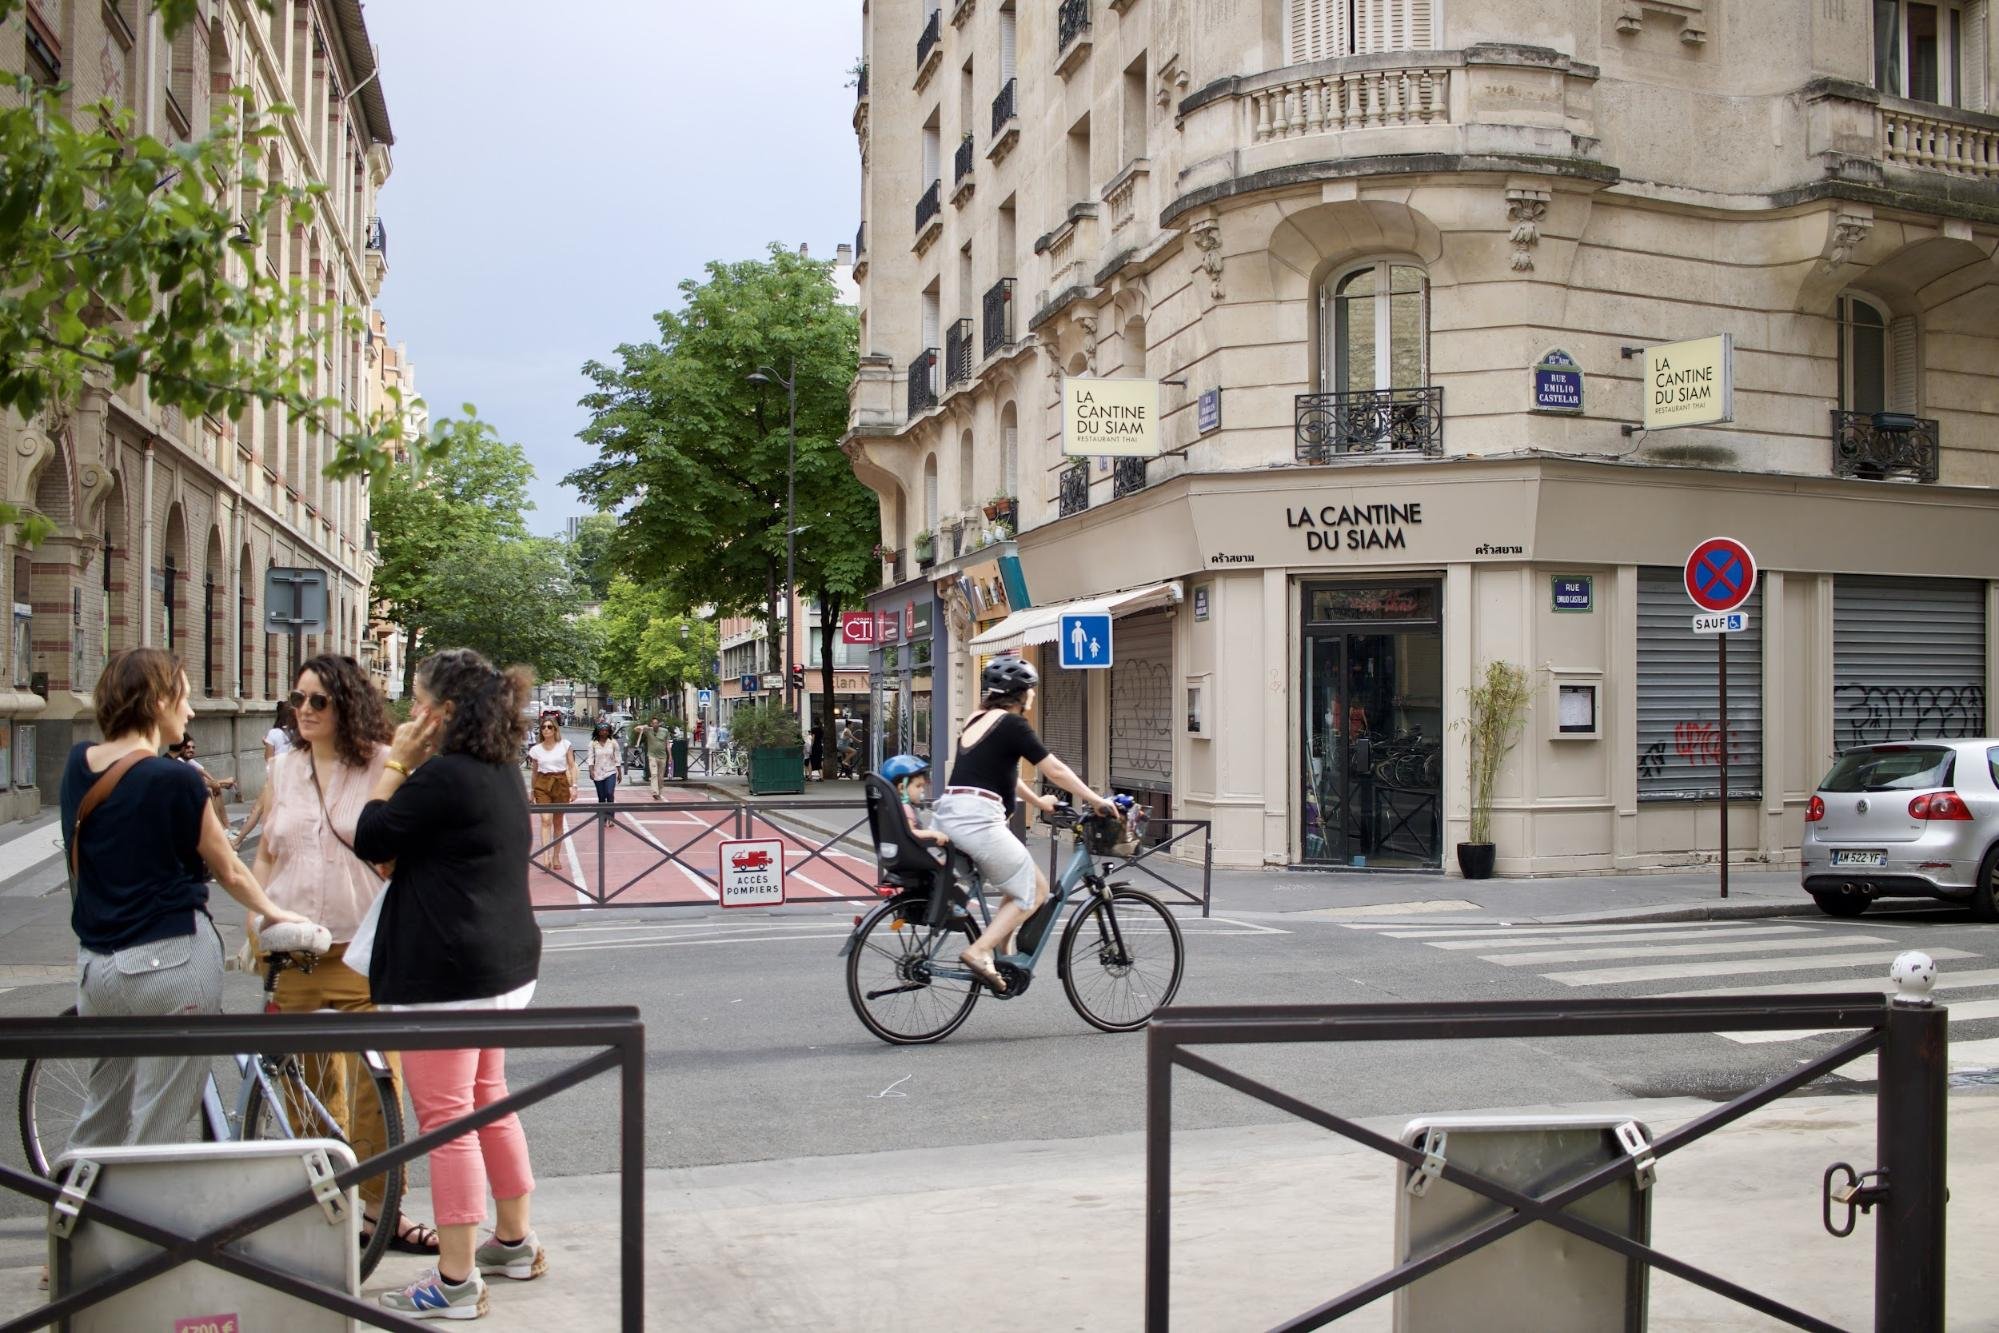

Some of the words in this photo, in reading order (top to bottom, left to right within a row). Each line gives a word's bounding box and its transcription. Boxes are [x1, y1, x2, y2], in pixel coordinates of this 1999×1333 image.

[1655, 357, 1671, 372] LA
[1551, 374, 1567, 383] RUE
[1656, 366, 1713, 388] CANTINE
[1544, 384, 1574, 393] EMILIO
[1655, 389, 1674, 405] DU
[1678, 385, 1711, 402] SIAM
[1076, 390, 1094, 404] LA
[1539, 393, 1579, 404] CASTELAR
[1077, 405, 1146, 420] CANTINE
[1655, 404, 1691, 415] RESTAURANT
[1077, 421, 1099, 434] DU
[1105, 420, 1144, 435] SIAM
[1077, 435, 1120, 443] RESTAURANT
[1286, 507, 1315, 528] LA
[1319, 503, 1422, 527] CANTINE
[1306, 530, 1340, 551] DU
[1347, 527, 1406, 550] SIAM
[1565, 583, 1580, 591] RUE
[1696, 617, 1726, 629] SAUF
[832, 675, 857, 689] lan
[726, 885, 779, 895] POMPIERS
[410, 1284, 451, 1312] N
